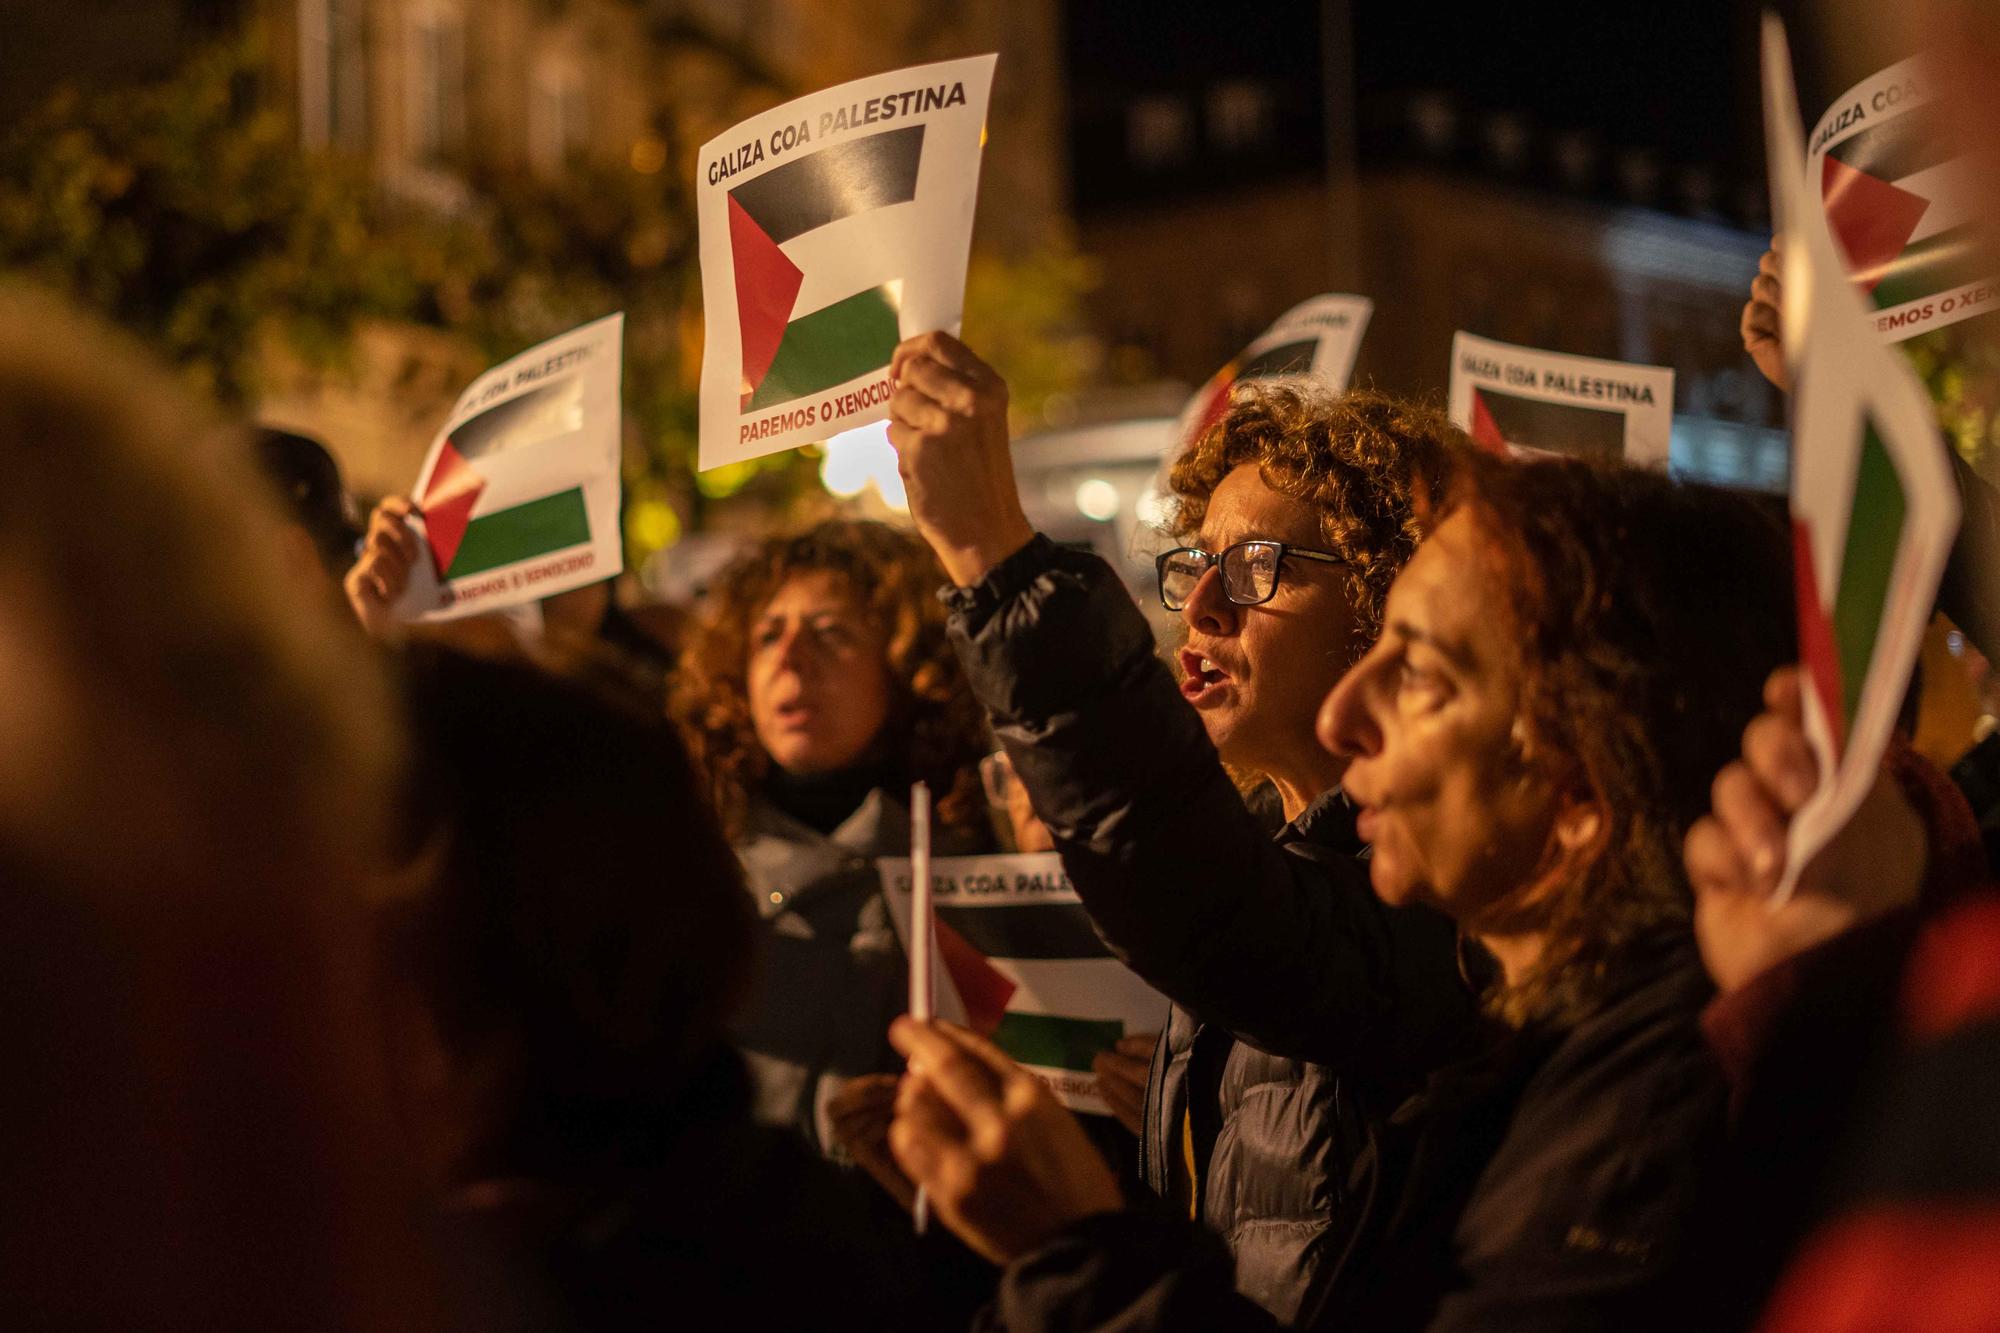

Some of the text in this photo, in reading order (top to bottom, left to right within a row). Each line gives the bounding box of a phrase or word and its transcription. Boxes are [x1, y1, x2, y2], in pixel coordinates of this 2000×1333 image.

[708, 81, 967, 186] GALIZA COA PALESTINA
[514, 343, 600, 385] PALESTI
[1543, 370, 1656, 405] PALESTINA
[739, 405, 817, 445] PAREMOS
[820, 401, 833, 423] O
